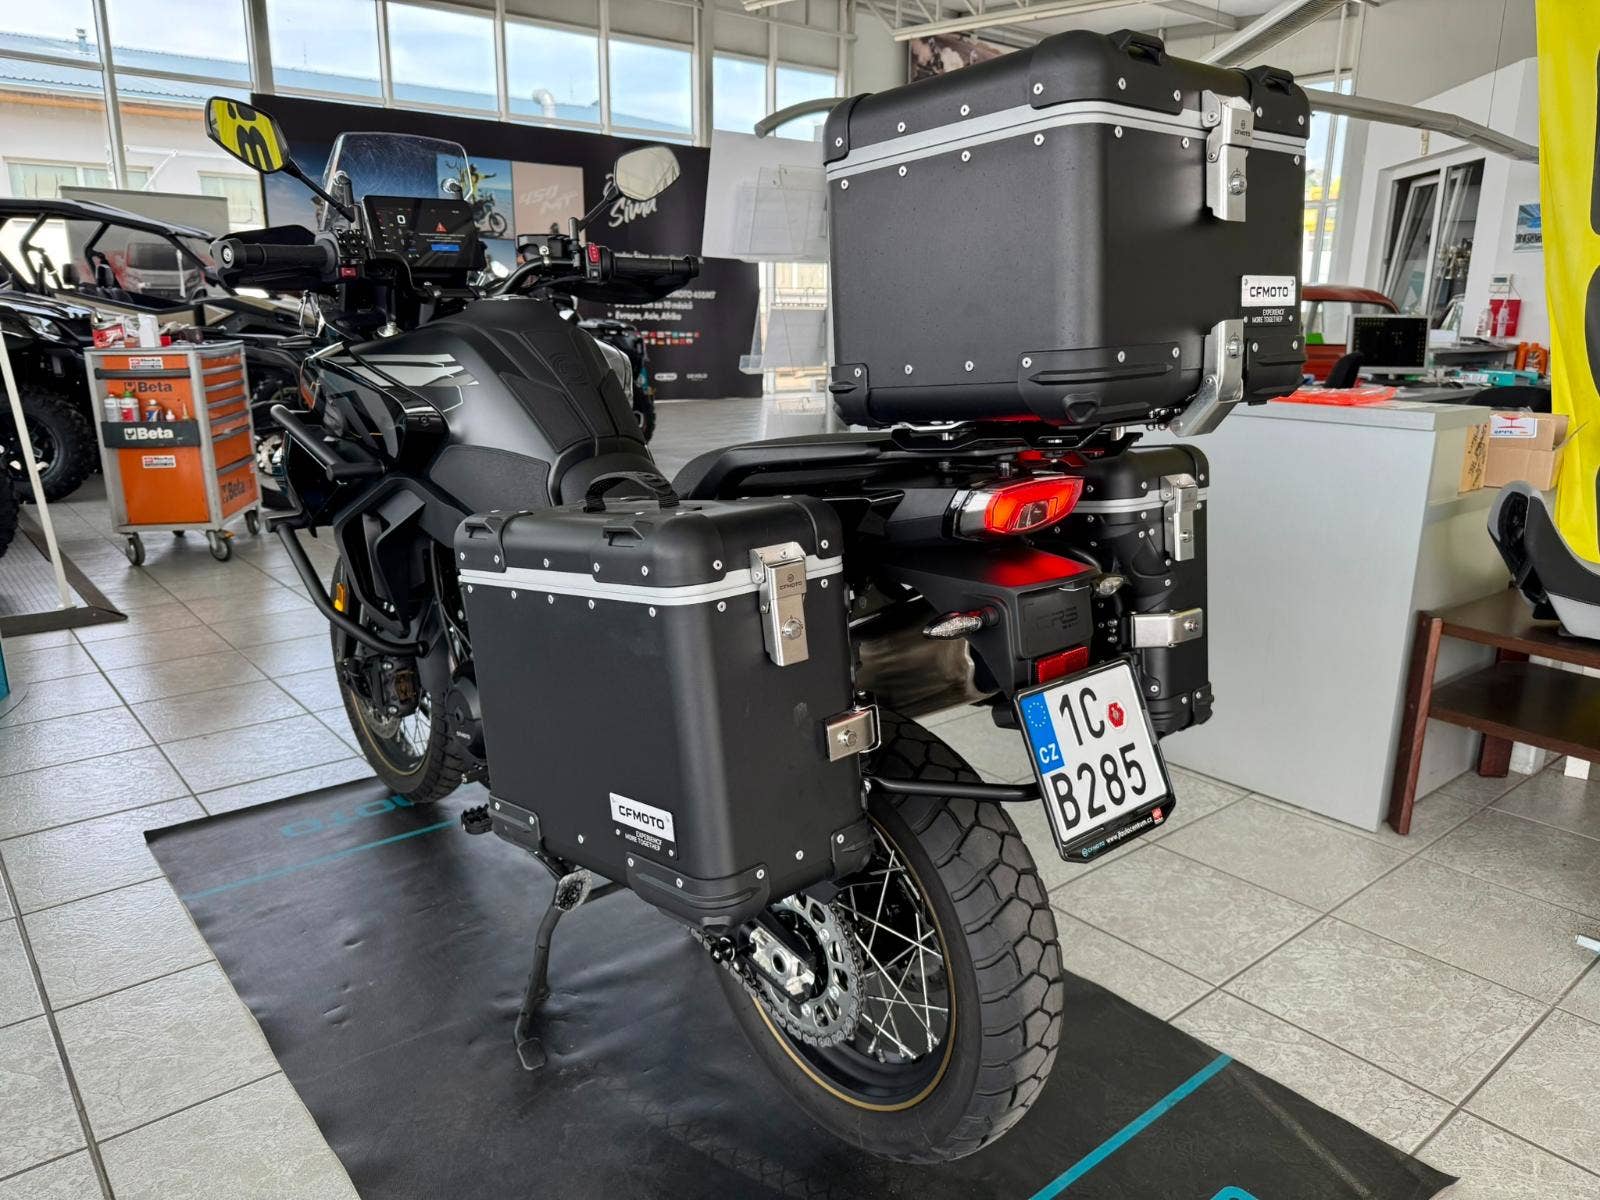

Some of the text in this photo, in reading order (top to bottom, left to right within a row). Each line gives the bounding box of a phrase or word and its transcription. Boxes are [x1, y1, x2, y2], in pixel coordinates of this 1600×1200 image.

[1249, 285, 1289, 298] CFMOTO
[614, 311, 682, 322] Evropa, Asie, Afrika
[1262, 308, 1285, 317] EXPERIENCE
[137, 381, 173, 393] Beta
[137, 427, 174, 440] Beta
[227, 478, 246, 500] Beta
[1059, 687, 1105, 746] 1C
[1039, 743, 1059, 765] CZ
[1050, 742, 1147, 831] B285
[618, 804, 665, 830] CFMOTO
[635, 830, 663, 846] EXPERIENCE
